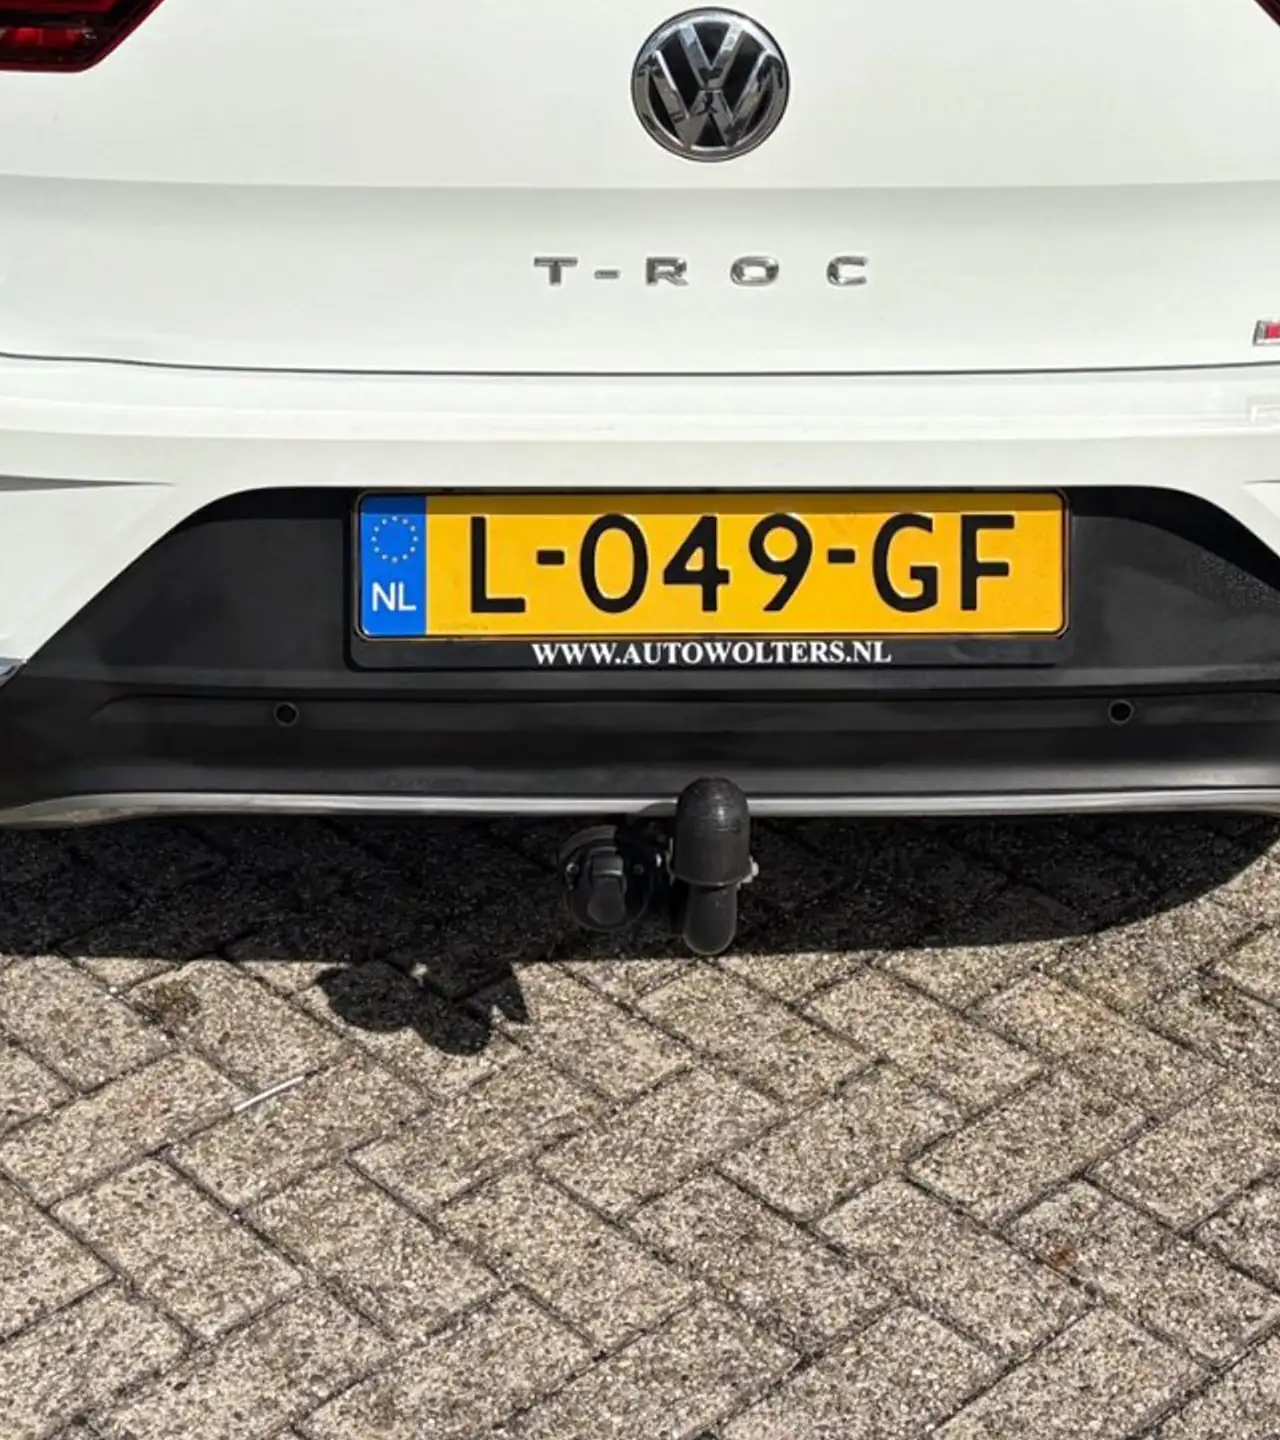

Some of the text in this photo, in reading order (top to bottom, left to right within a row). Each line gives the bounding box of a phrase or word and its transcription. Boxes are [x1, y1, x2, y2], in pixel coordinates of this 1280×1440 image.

[640, 12, 783, 156] VW
[372, 581, 417, 612] NL
[469, 513, 1016, 614] L-049-GF
[531, 640, 892, 665] WWW.AUTOWOLTERS.NL
